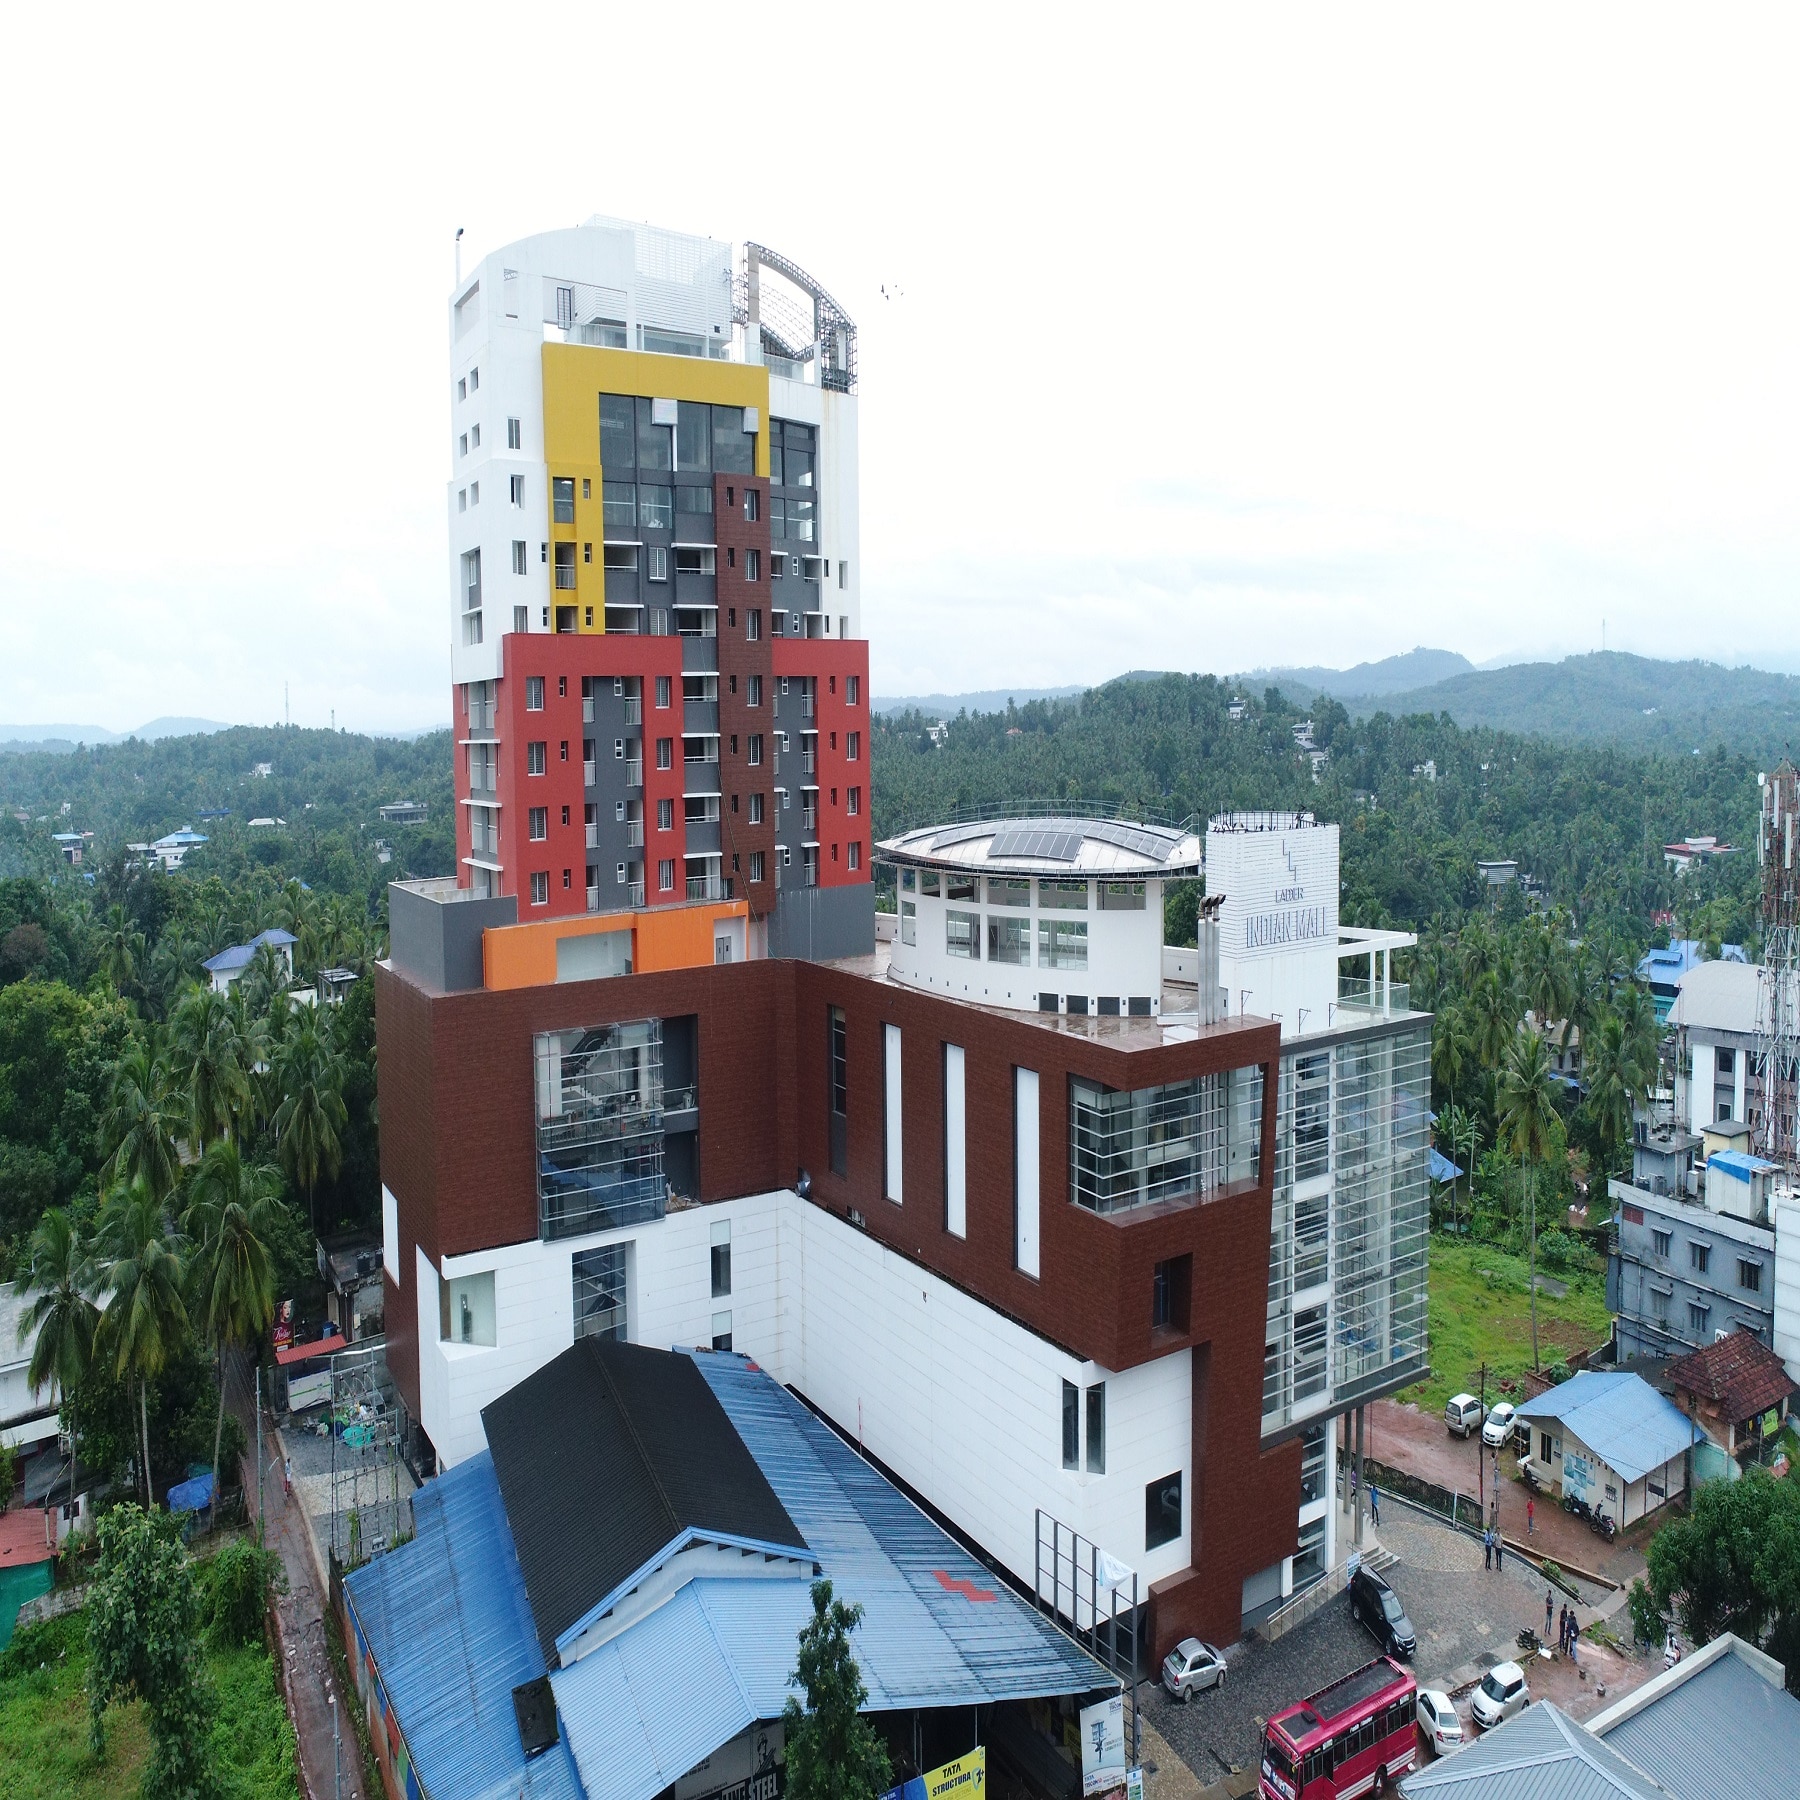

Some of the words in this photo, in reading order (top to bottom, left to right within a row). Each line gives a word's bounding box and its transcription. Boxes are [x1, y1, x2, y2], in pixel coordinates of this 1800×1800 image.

[1275, 887, 1304, 903] LADDER
[1246, 911, 1291, 948] INDIAN
[1295, 906, 1329, 941] MALL
[942, 1763, 962, 1779] TATA
[932, 1771, 971, 1797] STRUCTURA
